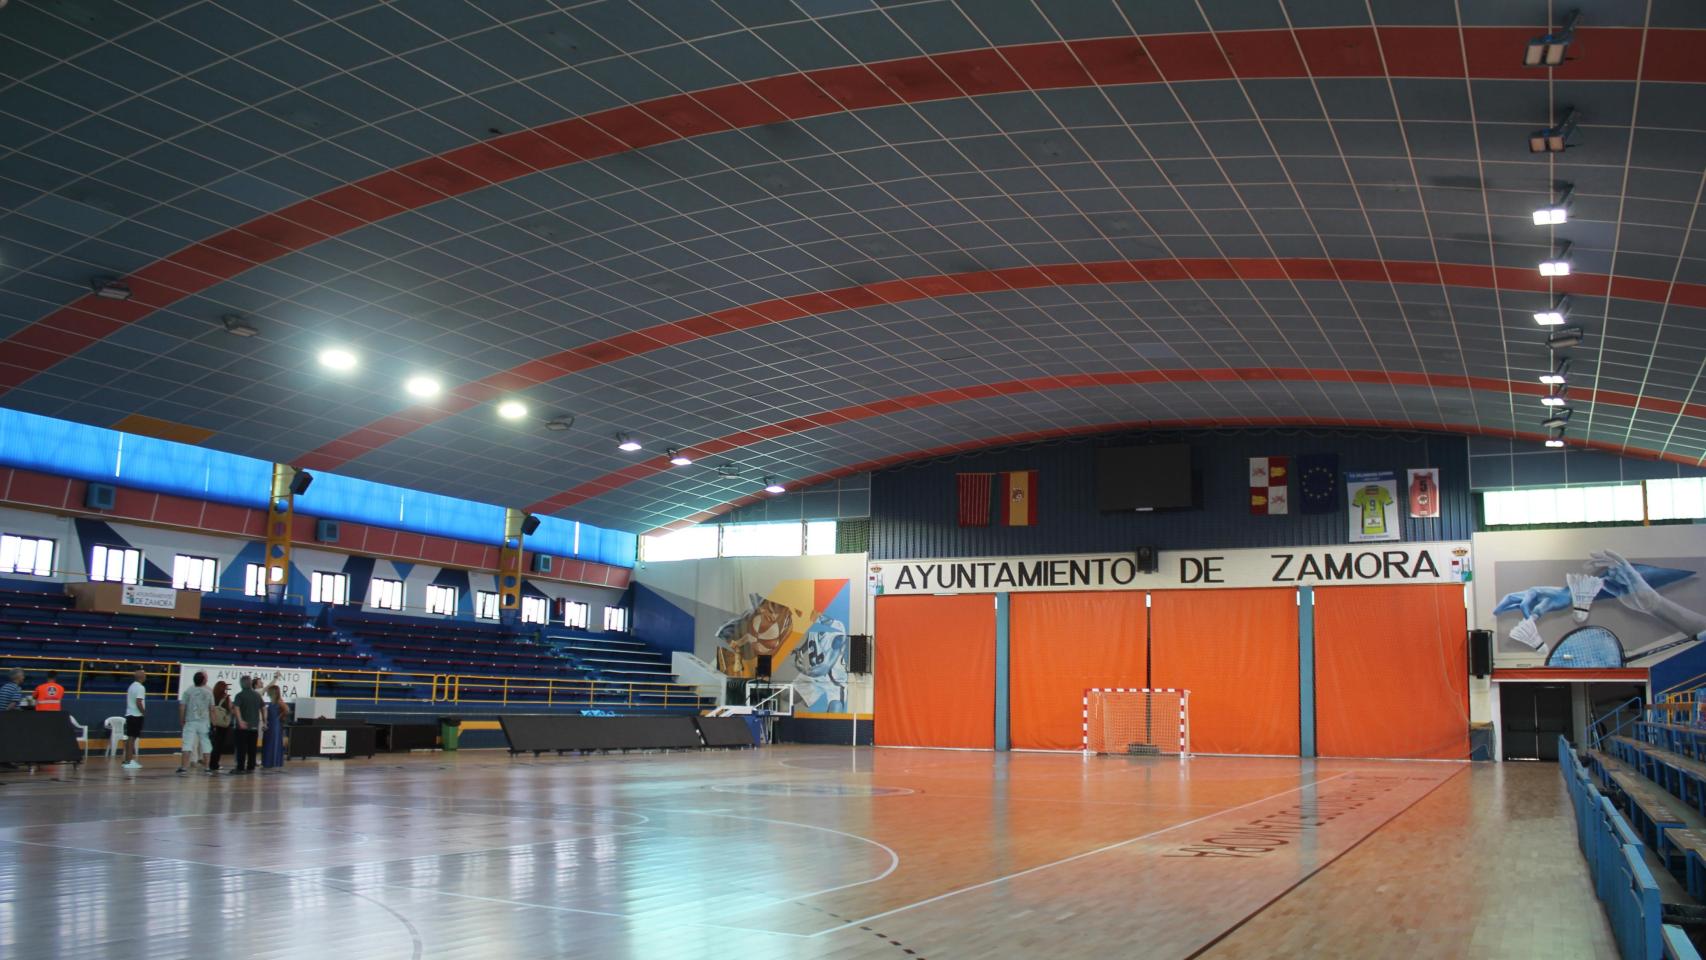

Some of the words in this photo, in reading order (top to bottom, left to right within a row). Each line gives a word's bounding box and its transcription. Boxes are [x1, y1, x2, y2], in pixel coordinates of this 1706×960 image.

[1369, 499, 1376, 511] 9
[895, 557, 1136, 590] AYUNTAMIENTO
[1180, 556, 1225, 584] DE
[1271, 550, 1441, 583] ZAMORA
